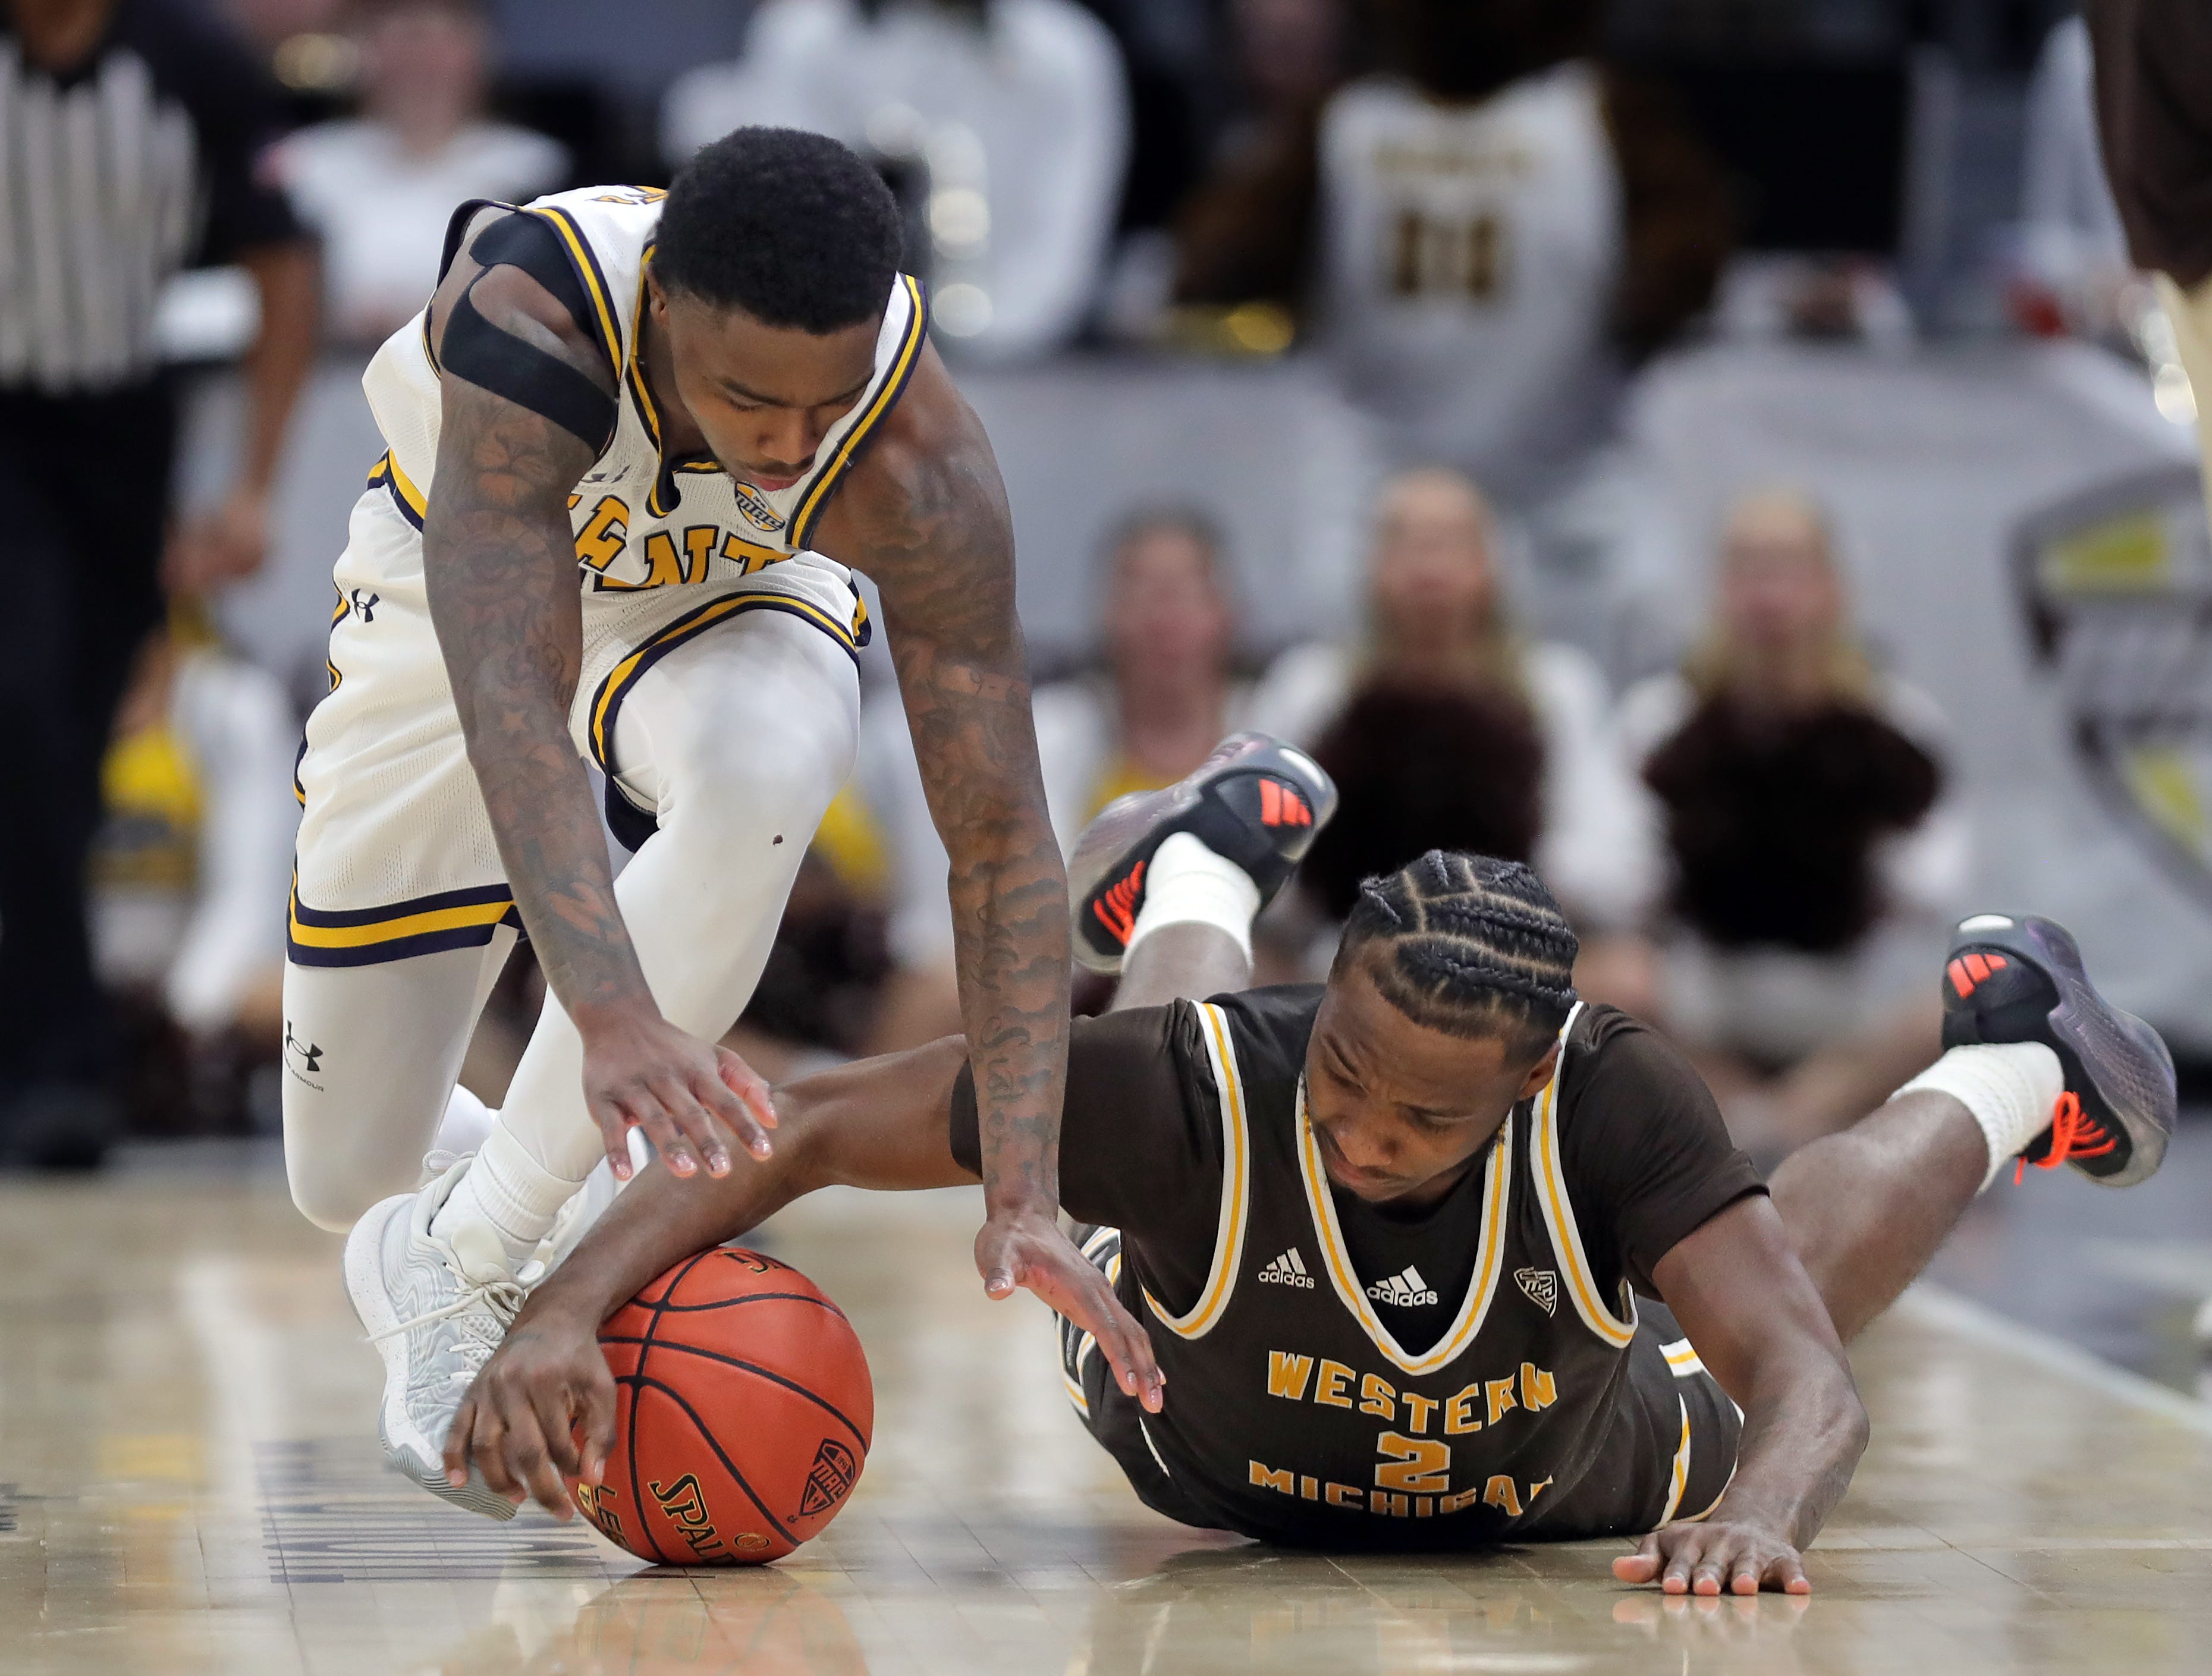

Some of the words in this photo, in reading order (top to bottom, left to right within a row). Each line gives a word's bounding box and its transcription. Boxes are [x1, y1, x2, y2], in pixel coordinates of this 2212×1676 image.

[567, 495, 794, 592] ENT
[1258, 1270, 1315, 1289] adidas
[1366, 1286, 1438, 1307] adidas
[1268, 1350, 1559, 1434] WESTERN
[1249, 1459, 1553, 1518] MICHIGA
[1374, 1430, 1451, 1493] 2
